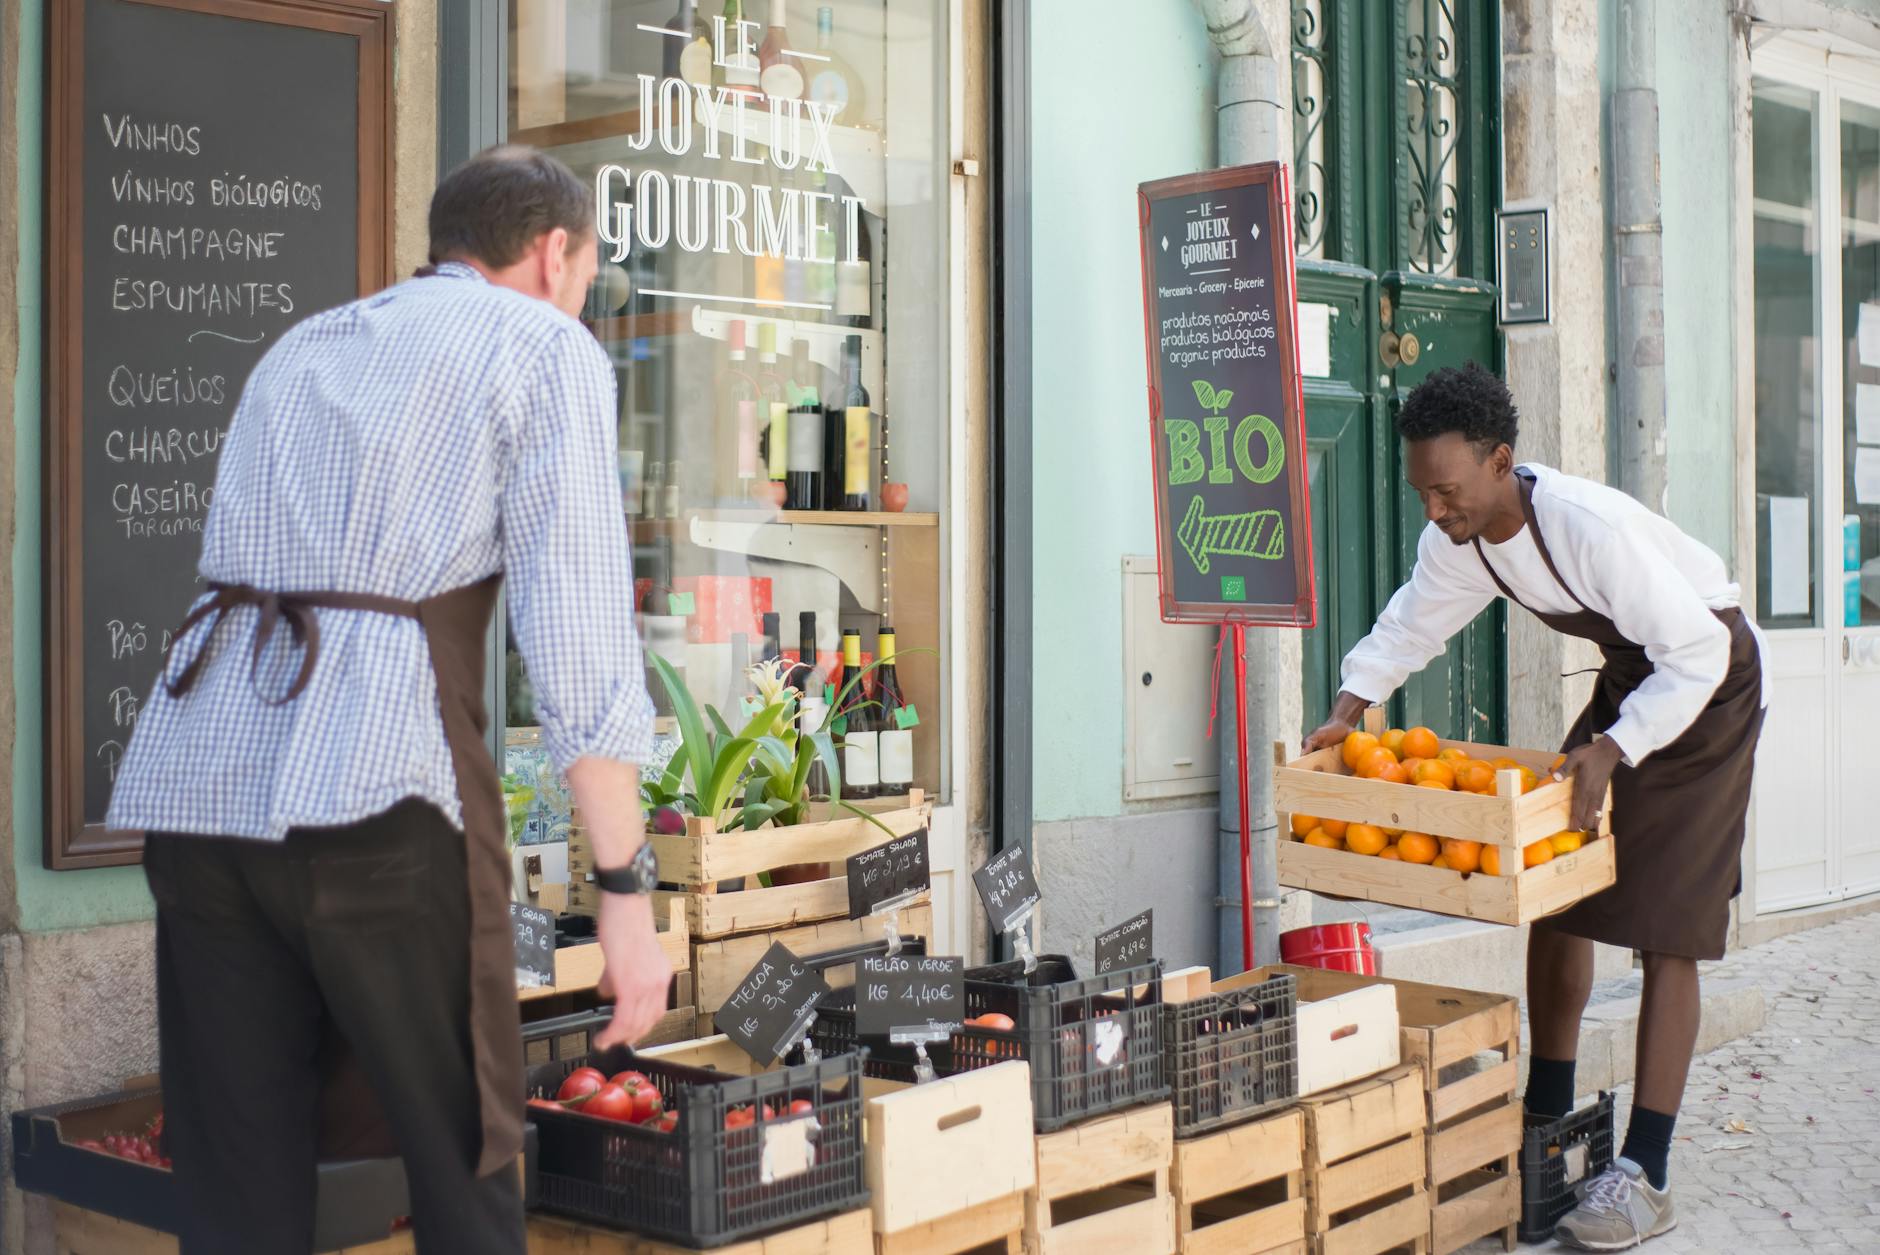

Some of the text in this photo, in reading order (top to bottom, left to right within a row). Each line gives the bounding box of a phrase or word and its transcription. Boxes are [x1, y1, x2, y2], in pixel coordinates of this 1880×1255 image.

[713, 15, 760, 72] LE
[628, 74, 840, 175] JOYEUX
[596, 165, 867, 266] GOURMET
[1200, 202, 1212, 217] LE
[113, 224, 285, 261] CHAMPAGNE
[1186, 217, 1230, 242] JOYEUX
[1181, 239, 1237, 269] GOURMET
[113, 278, 294, 317] ESPUMANTES
[1158, 284, 1193, 299] Mercearia
[1199, 281, 1228, 295] Grocery
[1234, 277, 1265, 293] Epicerie
[1162, 303, 1270, 335] produtos nacionais
[1160, 323, 1275, 352] produtos biológicos
[1169, 341, 1266, 368] organic products
[105, 425, 228, 465] CHARCU
[1164, 414, 1286, 486] BIO
[855, 837, 918, 865] TOMATE SALADA
[521, 907, 548, 926] GRAPA
[540, 935, 548, 951] €
[790, 963, 805, 977] €
[864, 956, 954, 973] MELÃO VERDE
[731, 962, 775, 1009] MELOA
